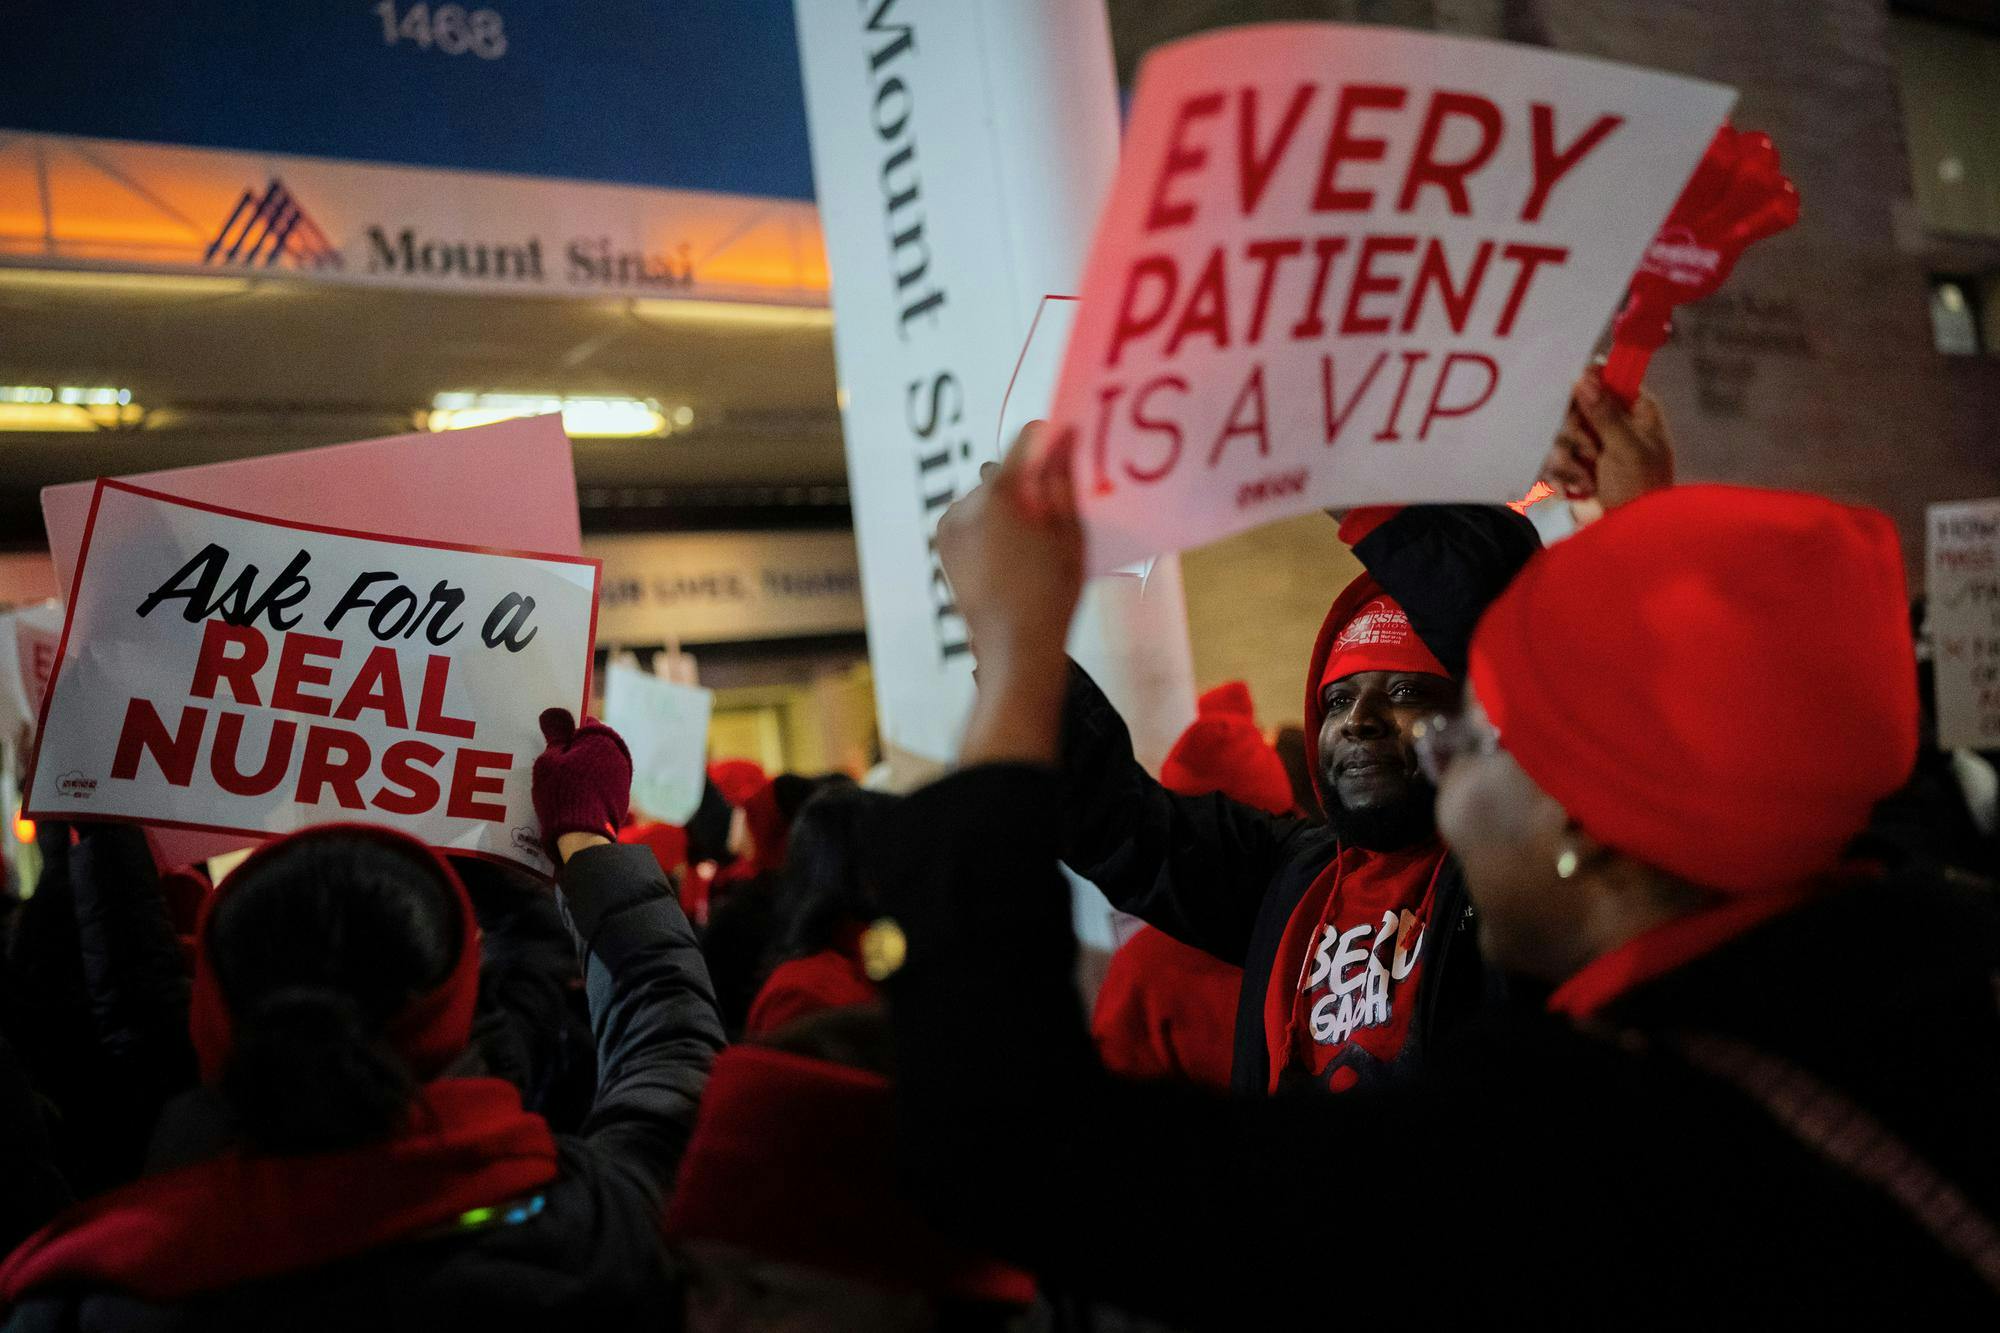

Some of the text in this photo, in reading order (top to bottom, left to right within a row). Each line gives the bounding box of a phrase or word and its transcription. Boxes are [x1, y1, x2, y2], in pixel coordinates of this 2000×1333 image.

[377, 0, 509, 61] 1468
[861, 0, 945, 341] Mount
[1145, 82, 1623, 233] EVERY
[367, 223, 696, 288] Mount Sinai
[1105, 235, 1570, 369] PATIENT
[1093, 350, 1499, 497] IS A VIP
[136, 542, 538, 653] Ask For a
[189, 618, 477, 740] REAL
[110, 696, 514, 824] NURSE
